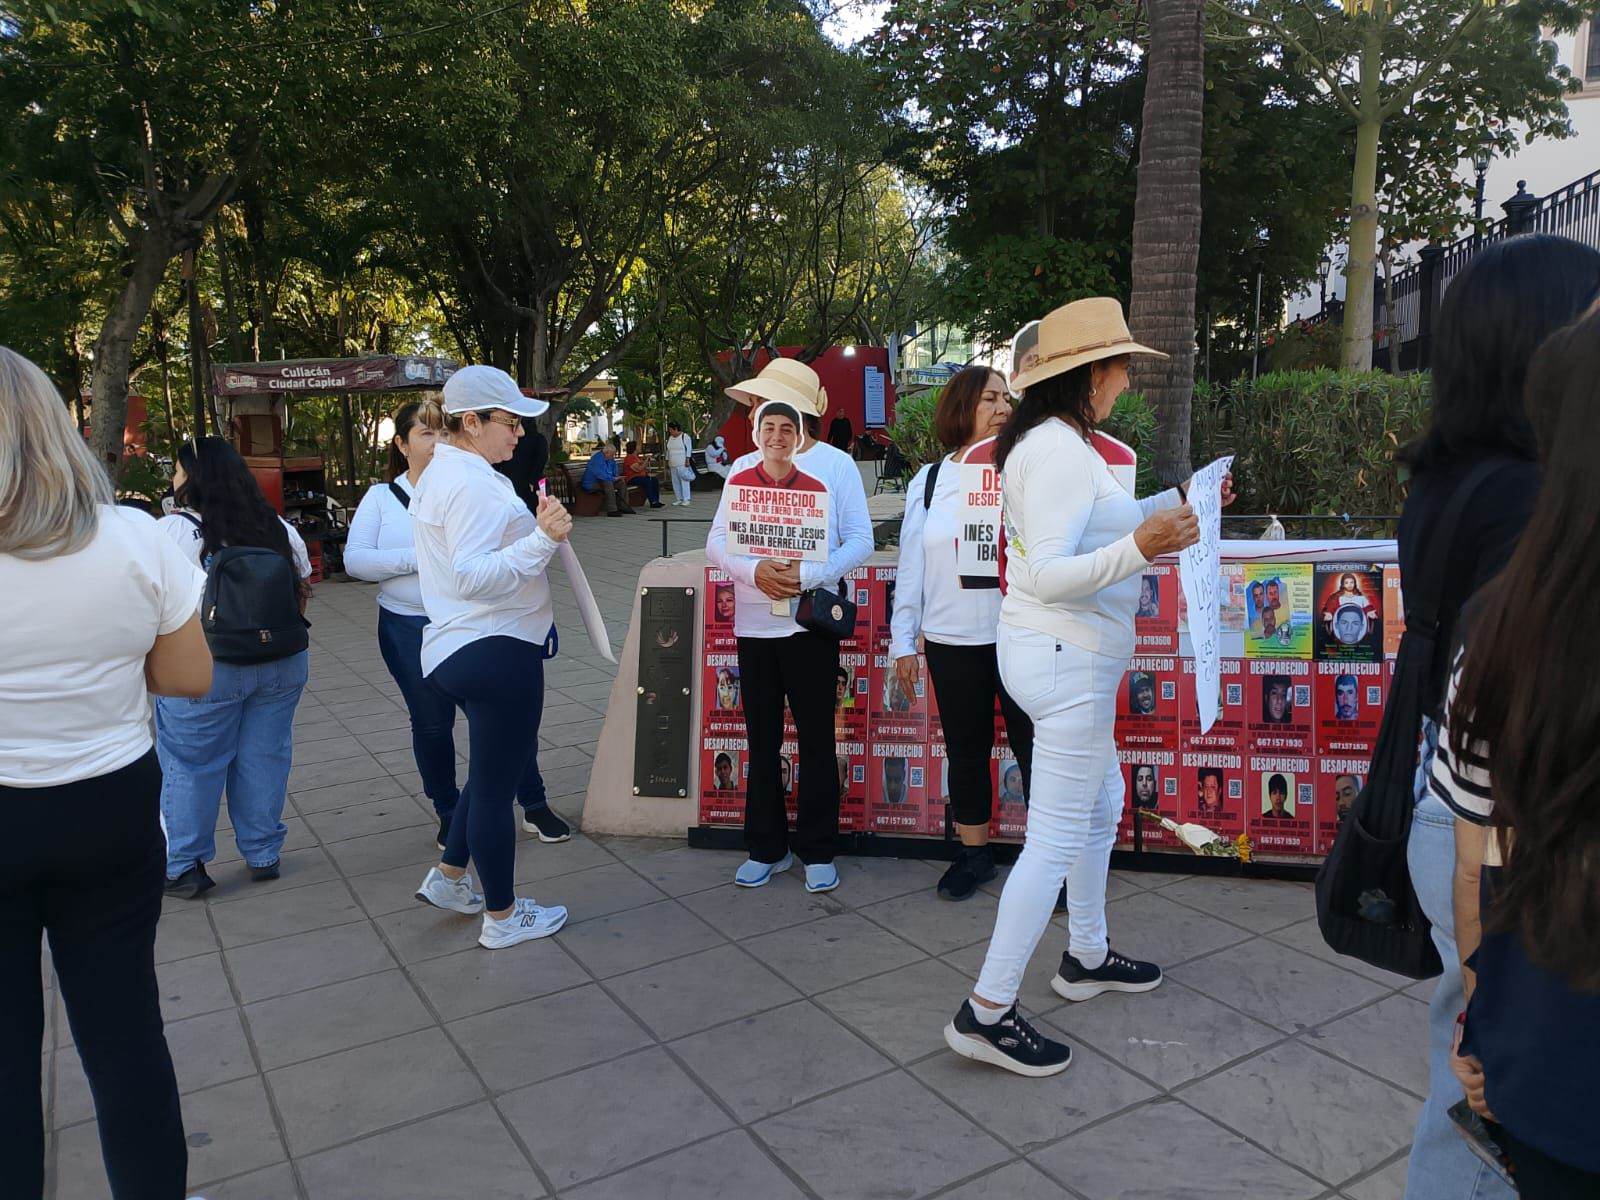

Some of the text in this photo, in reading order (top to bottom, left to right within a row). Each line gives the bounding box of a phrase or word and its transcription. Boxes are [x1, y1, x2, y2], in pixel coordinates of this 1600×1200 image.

[268, 379, 306, 389] Ciudad
[307, 377, 346, 389] Capital
[739, 488, 816, 508] DESAPARECIDO
[968, 492, 1000, 506] DESDE
[731, 502, 750, 513] DESDE
[762, 504, 770, 514] DE
[771, 505, 792, 516] ENERO
[793, 507, 805, 517] DEL
[749, 522, 784, 537] ALBERTO
[786, 526, 797, 538] DE
[964, 520, 994, 541] INÉS
[737, 533, 816, 551] IBARRA BERRELLEZA
[977, 543, 999, 561] IBA
[707, 654, 739, 667] DESAPARE
[1128, 658, 1175, 671] APARECIDO
[1183, 660, 1241, 674] DESECIDO
[1250, 661, 1309, 675] DESAPARECIDO
[1318, 662, 1380, 675] DESAPARECIDO
[703, 738, 749, 751] DESAPARECID
[836, 743, 865, 756] ARECIDO
[872, 744, 923, 758] DESAPARECIDO
[1118, 750, 1175, 765] DESAPARECIDO
[1182, 753, 1242, 768] DESAPARECIDO
[1250, 757, 1310, 772] DESAPARECIDO
[1320, 759, 1370, 774] DESAPARECI
[520, 914, 537, 928] N
